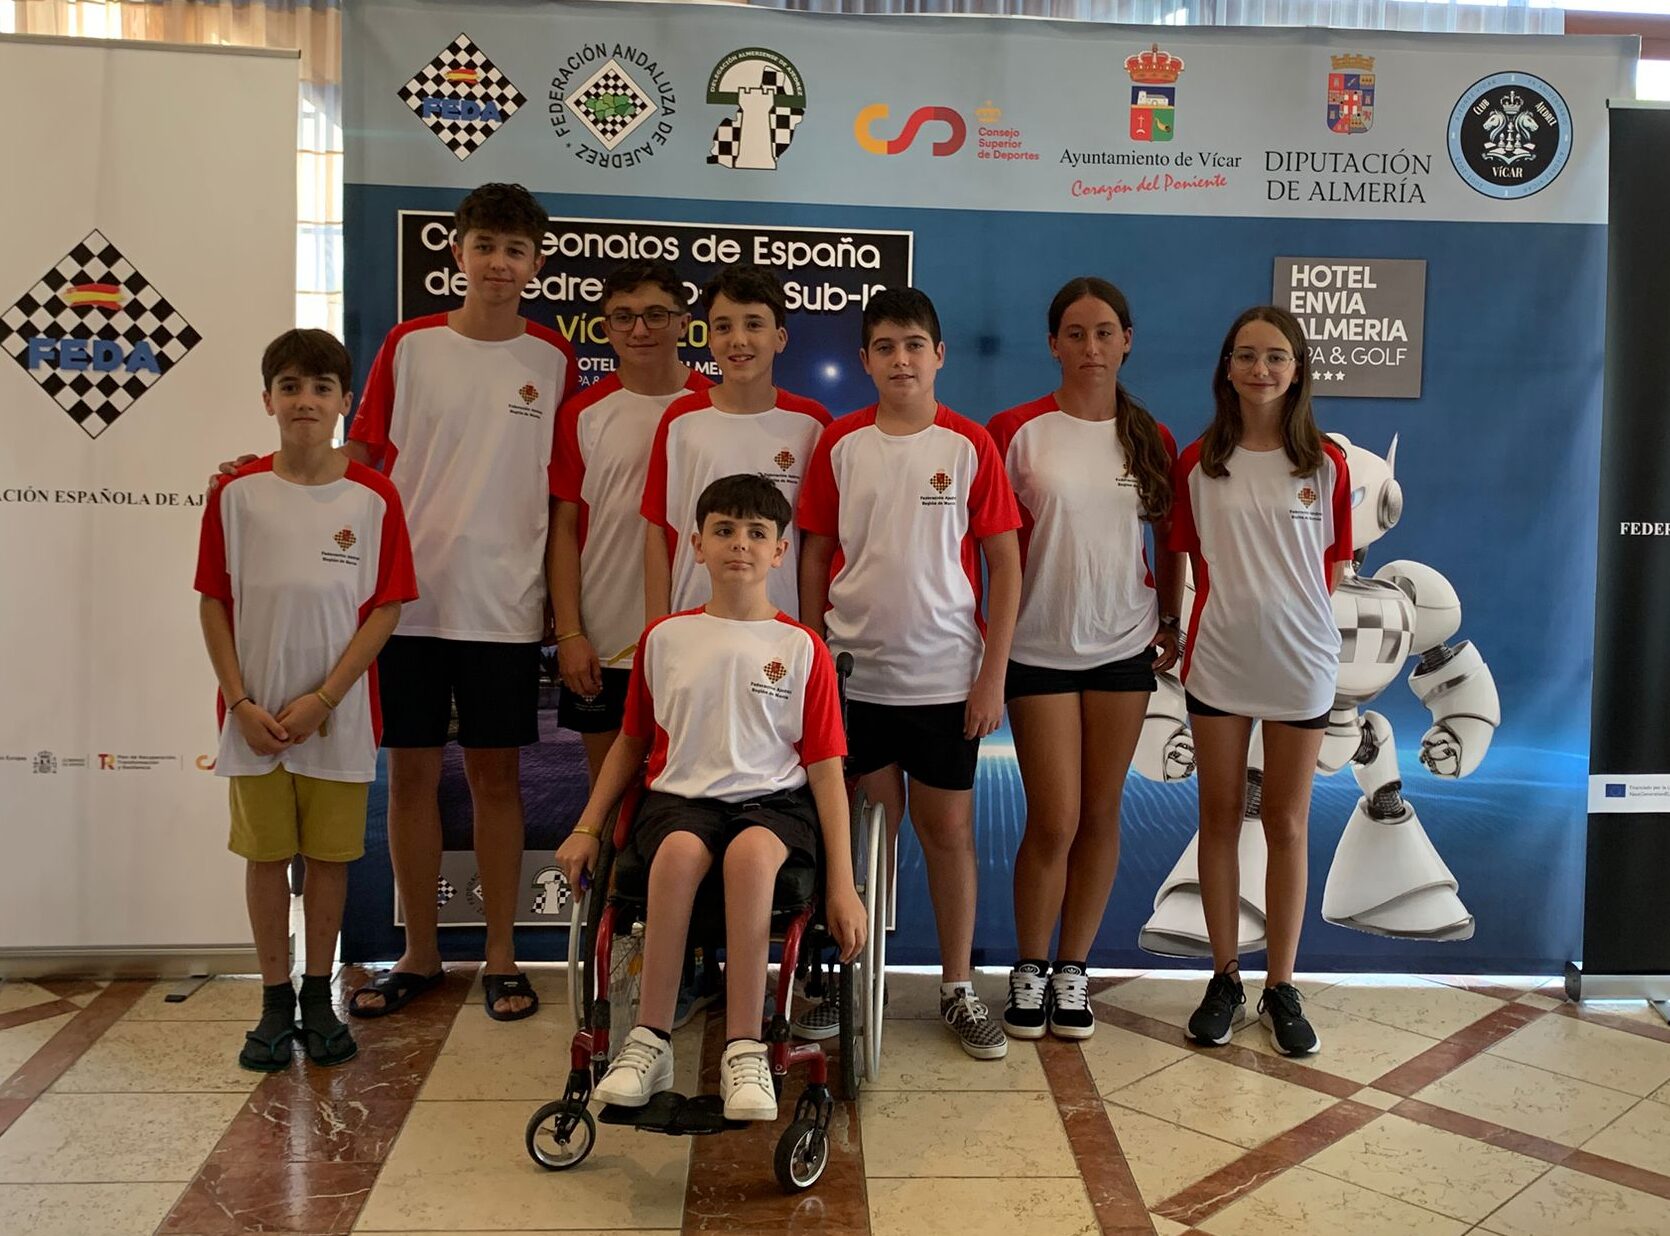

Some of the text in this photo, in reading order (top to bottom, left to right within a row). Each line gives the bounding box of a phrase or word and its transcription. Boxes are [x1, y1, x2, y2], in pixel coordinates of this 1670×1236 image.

[422, 96, 503, 123] FEDA
[549, 43, 676, 169] FEDERACIÓN ANDALUZA DE AJEDREZ
[978, 127, 1020, 139] Consejo
[978, 138, 1022, 150] Superior
[977, 149, 1040, 161] de Deportes
[1059, 149, 1242, 168] Ayuntamiento de Vícar
[1265, 148, 1432, 175] DIPUTACIÓN
[1071, 173, 1228, 200] Corazón del Poniente
[1267, 177, 1426, 203] DE ALMERÍA
[420, 221, 881, 270] Ceonatos de España
[520, 272, 606, 302] edre
[1291, 265, 1377, 288] HOTEL
[1290, 291, 1366, 314] ENVÍA
[28, 336, 162, 374] FEDA
[576, 357, 616, 372] OTEL
[1329, 346, 1347, 364] &
[1351, 347, 1407, 366] GOLF
[55, 488, 150, 505] ESPAÑOLA
[155, 493, 179, 506] DE
